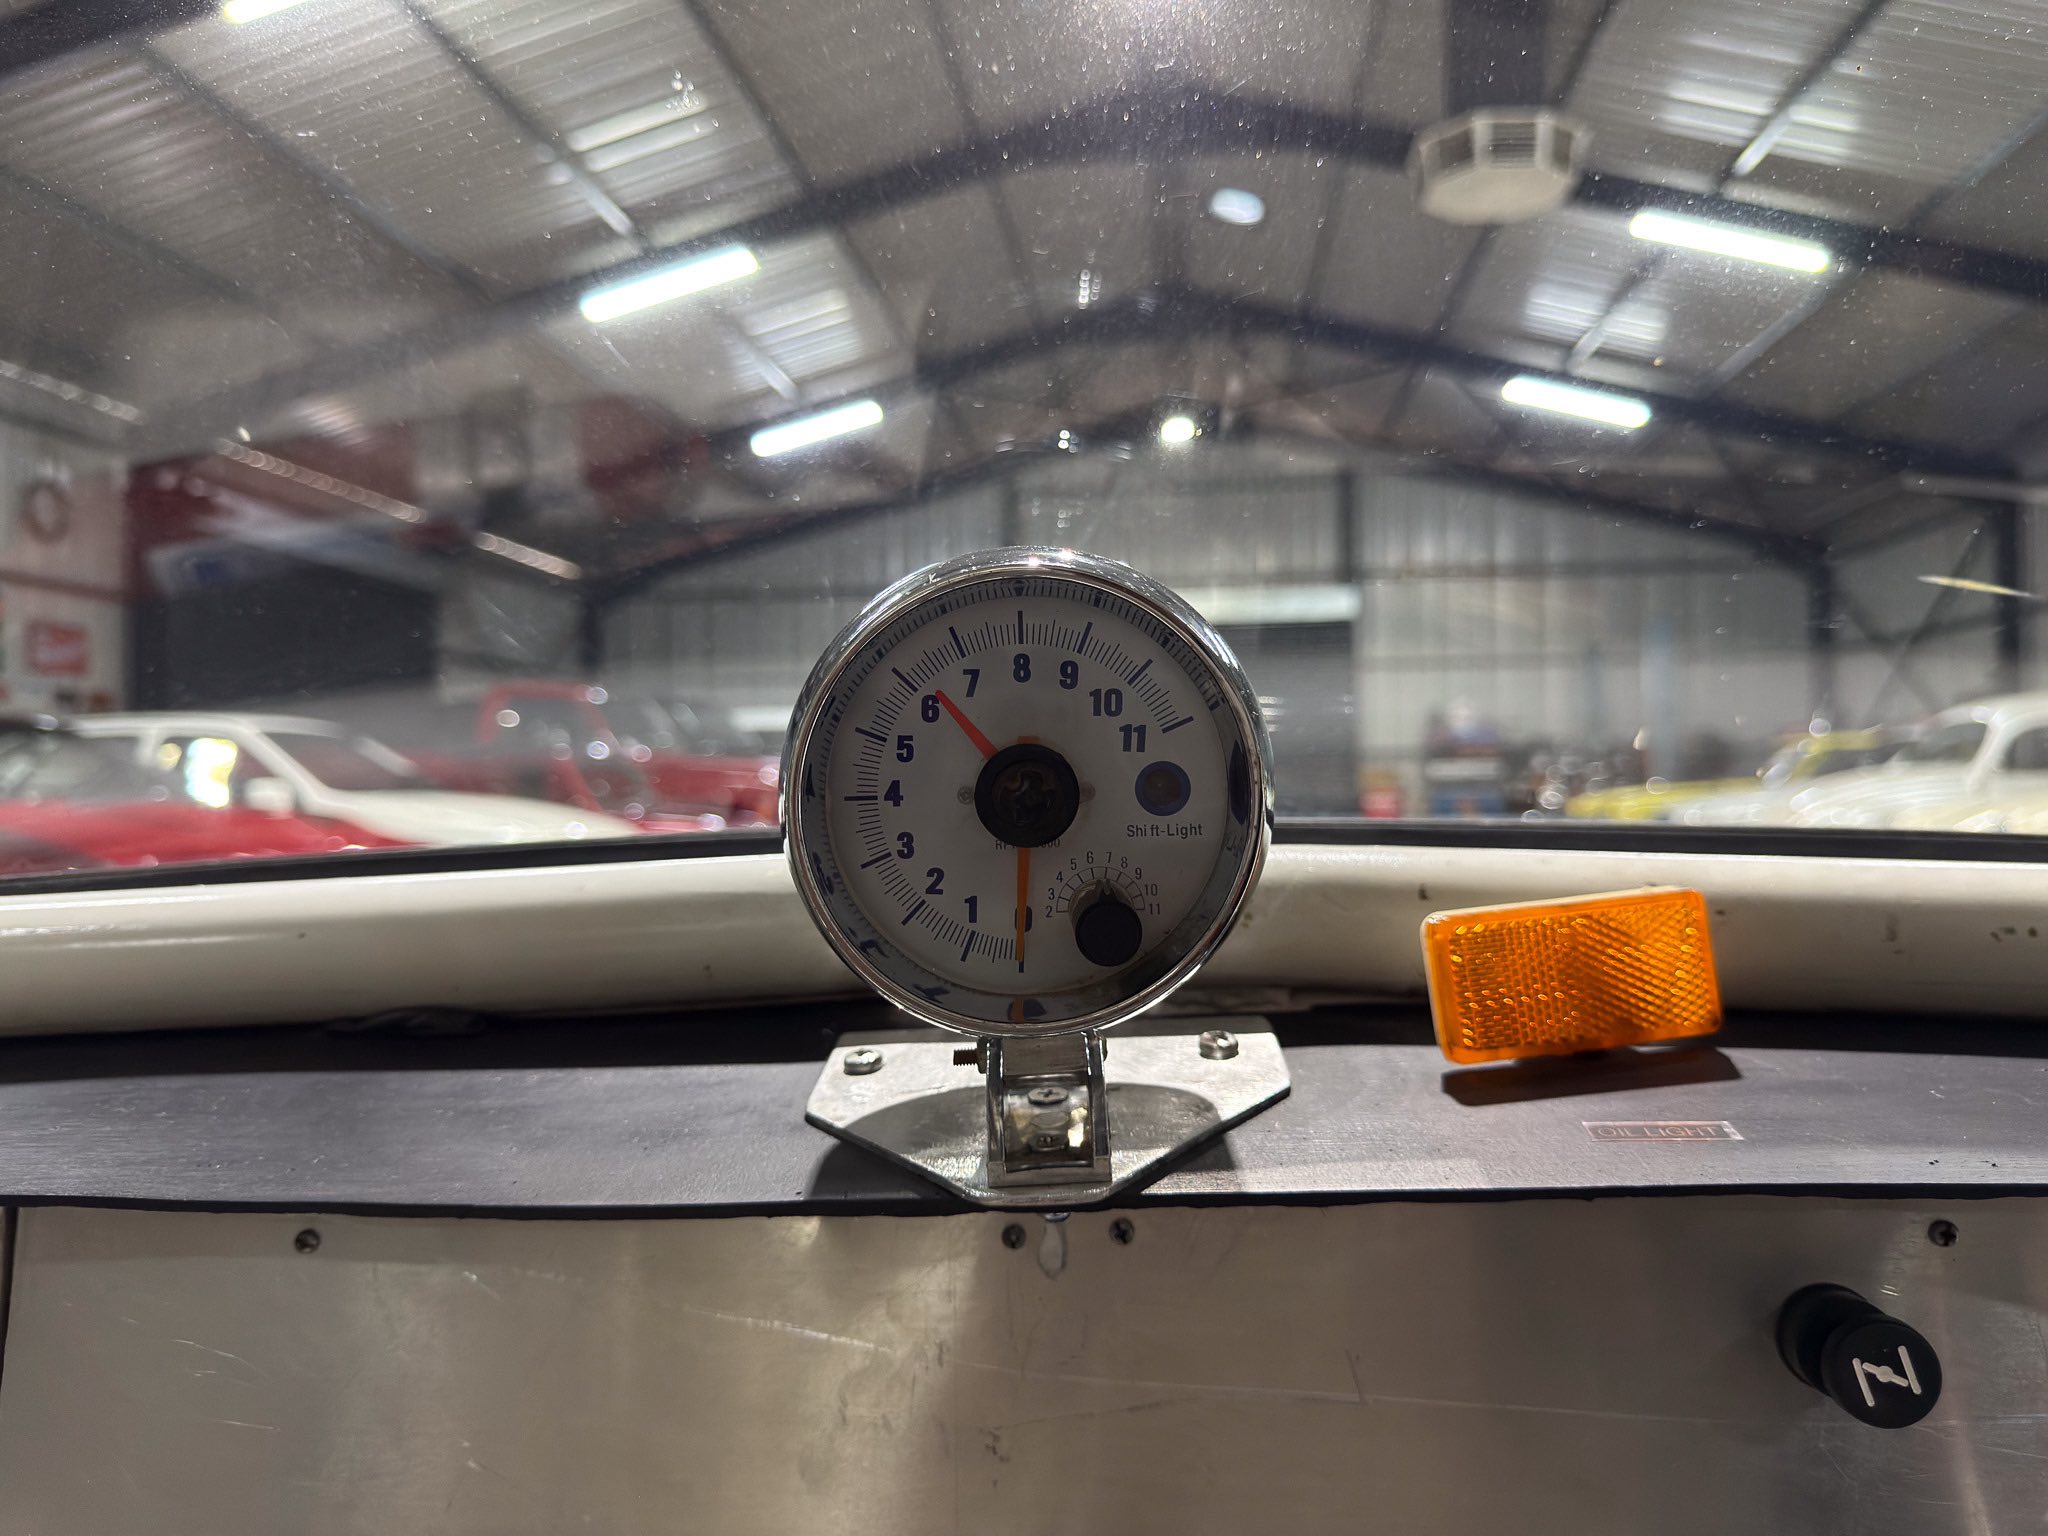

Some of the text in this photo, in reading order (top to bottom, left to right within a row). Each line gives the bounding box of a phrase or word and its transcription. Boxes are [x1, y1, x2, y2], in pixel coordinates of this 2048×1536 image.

[1013, 653, 1031, 683] 8
[1059, 660, 1079, 690] 9
[963, 669, 980, 698] 7
[921, 694, 940, 723] 6
[1089, 687, 1123, 717] 10
[1119, 724, 1147, 753] 11
[896, 735, 914, 763] 5
[884, 780, 903, 807] 4
[1126, 823, 1203, 839] Shift-Light
[897, 832, 915, 859] 3
[1070, 858, 1077, 871] 5
[1086, 851, 1094, 864] 6
[1106, 852, 1112, 864] 7
[1120, 856, 1128, 868] 8
[925, 867, 945, 895] 2
[1056, 871, 1063, 883] 4
[1135, 867, 1142, 880] 9
[1048, 888, 1055, 900] 3
[1145, 884, 1158, 896] 10
[964, 895, 978, 924] 1
[1045, 906, 1053, 918] 2
[1149, 903, 1161, 915] 11
[1598, 1125, 1717, 1138] OIL LIGHT
